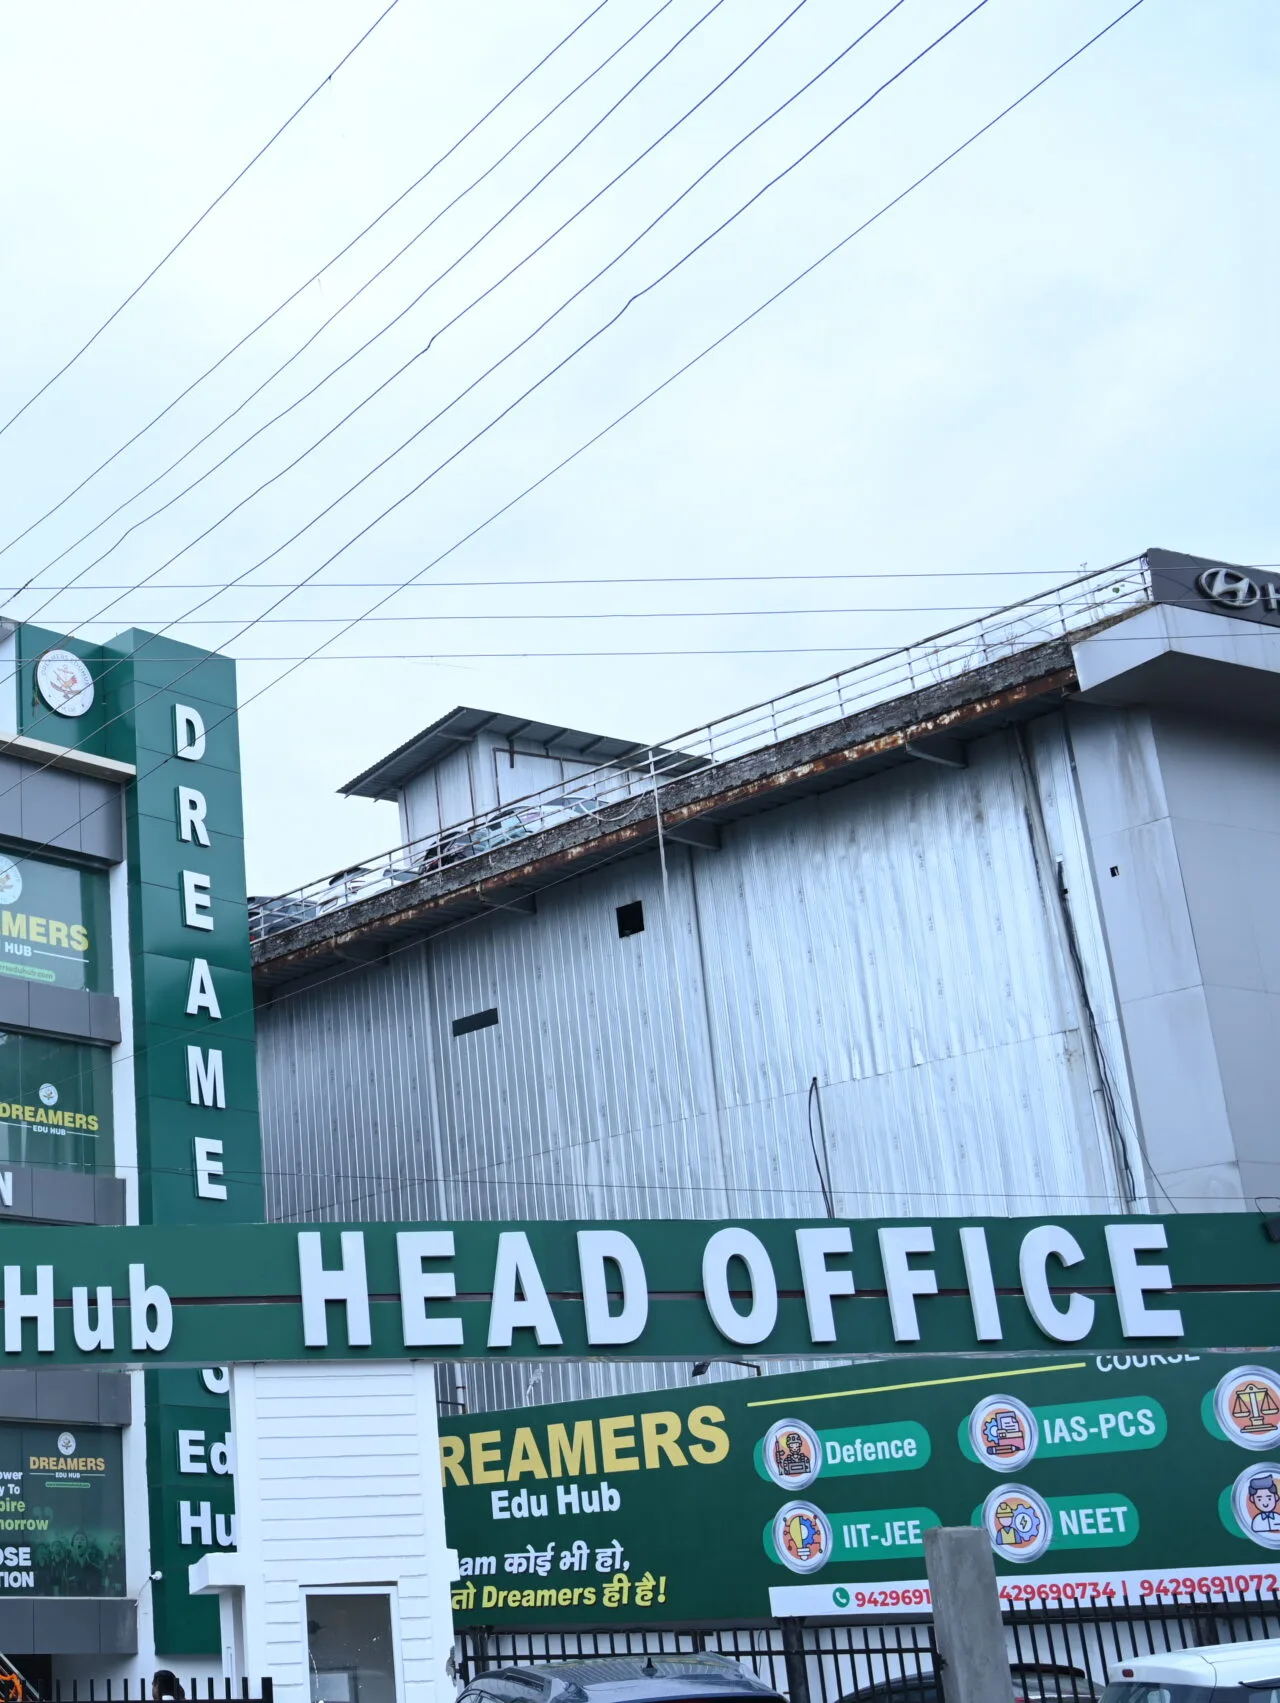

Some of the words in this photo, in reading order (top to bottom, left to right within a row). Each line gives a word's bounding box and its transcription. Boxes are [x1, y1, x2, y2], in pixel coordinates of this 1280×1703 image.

[4, 938, 32, 957] HUB
[33, 1124, 49, 1133] EDU
[50, 1126, 66, 1136] HUB
[3, 1263, 174, 1354] Hub
[298, 1230, 649, 1347] HEAD
[702, 1223, 1185, 1345] OFFICE
[177, 1430, 234, 1475] Ed
[440, 1405, 730, 1488] REAMERS
[825, 1437, 917, 1466] Defence
[1043, 1408, 1156, 1445] IAS-PCS
[29, 1456, 105, 1471] DREAMERS
[7, 1483, 21, 1495] To
[491, 1489, 548, 1519] Edu
[556, 1481, 621, 1515] Hub
[178, 1500, 236, 1547] Hu
[842, 1519, 923, 1549] IIT-JEE
[1059, 1506, 1128, 1536] NEET
[458, 1555, 496, 1577] am
[504, 1542, 555, 1577] कोई
[560, 1540, 590, 1571] भी
[595, 1539, 630, 1572] हो,
[482, 1586, 596, 1609] Dreamers
[603, 1573, 631, 1608] ही
[855, 1588, 932, 1608] 9429691
[998, 1580, 1116, 1602] 429690734
[1140, 1573, 1279, 1599] 9429691072
